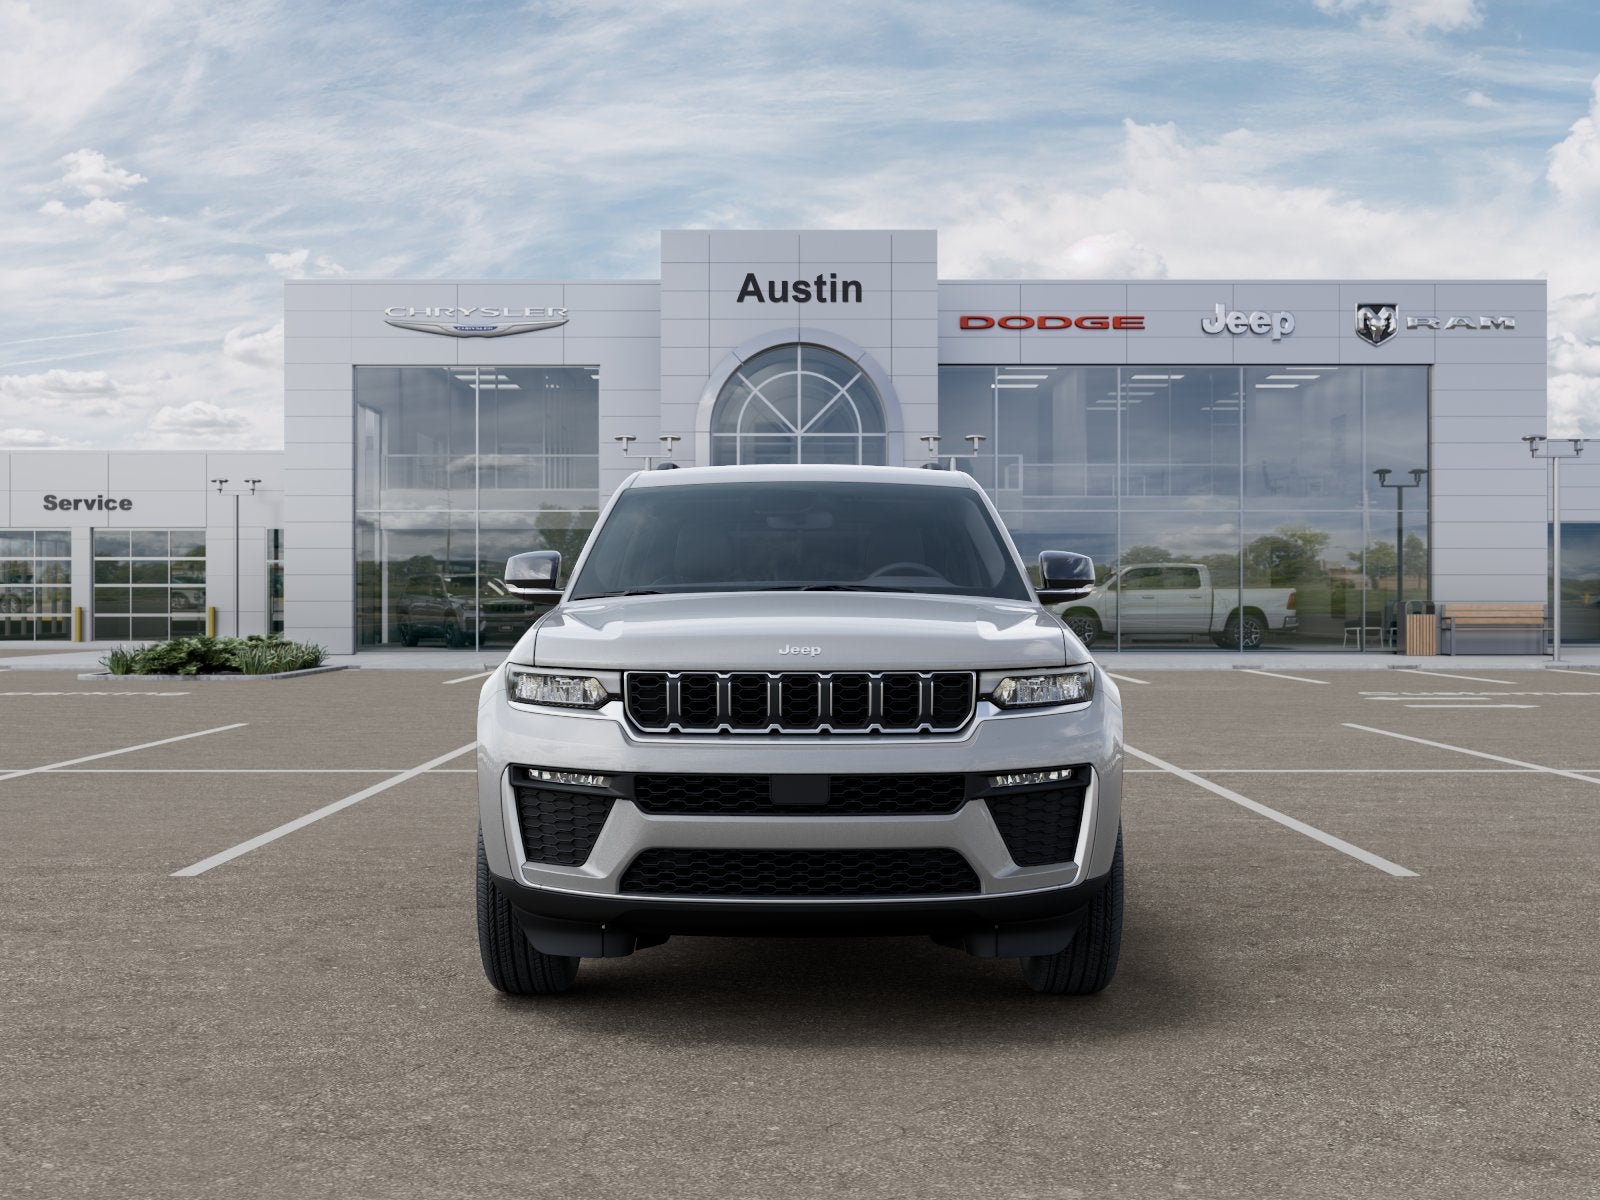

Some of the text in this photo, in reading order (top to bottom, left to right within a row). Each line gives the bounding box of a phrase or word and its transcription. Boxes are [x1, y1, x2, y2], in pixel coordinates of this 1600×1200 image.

[736, 272, 863, 303] Austin
[384, 306, 569, 317] CHRYSLER
[959, 315, 1146, 330] DODGE
[1201, 303, 1295, 341] Jeep
[1406, 315, 1516, 330] RAM
[43, 494, 133, 511] Service
[778, 643, 822, 658] Jeep
